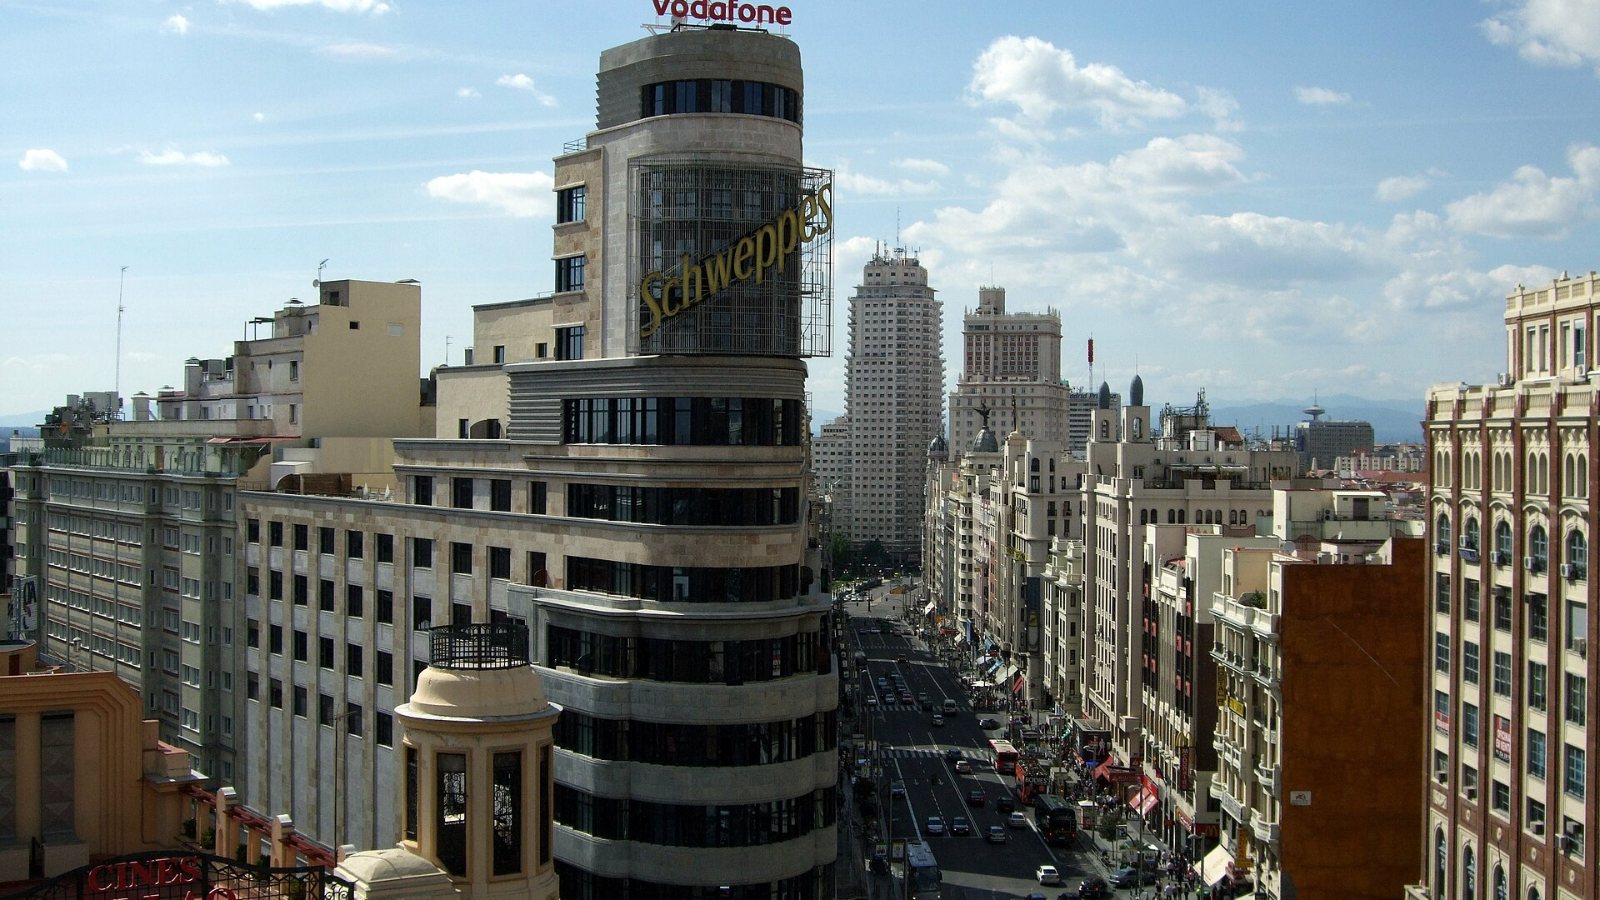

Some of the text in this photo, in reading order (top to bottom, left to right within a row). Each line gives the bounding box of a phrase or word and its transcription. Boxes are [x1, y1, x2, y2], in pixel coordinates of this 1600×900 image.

[652, 0, 792, 25] vodafone
[640, 183, 832, 338] Schweppes
[87, 856, 201, 893] CINES
